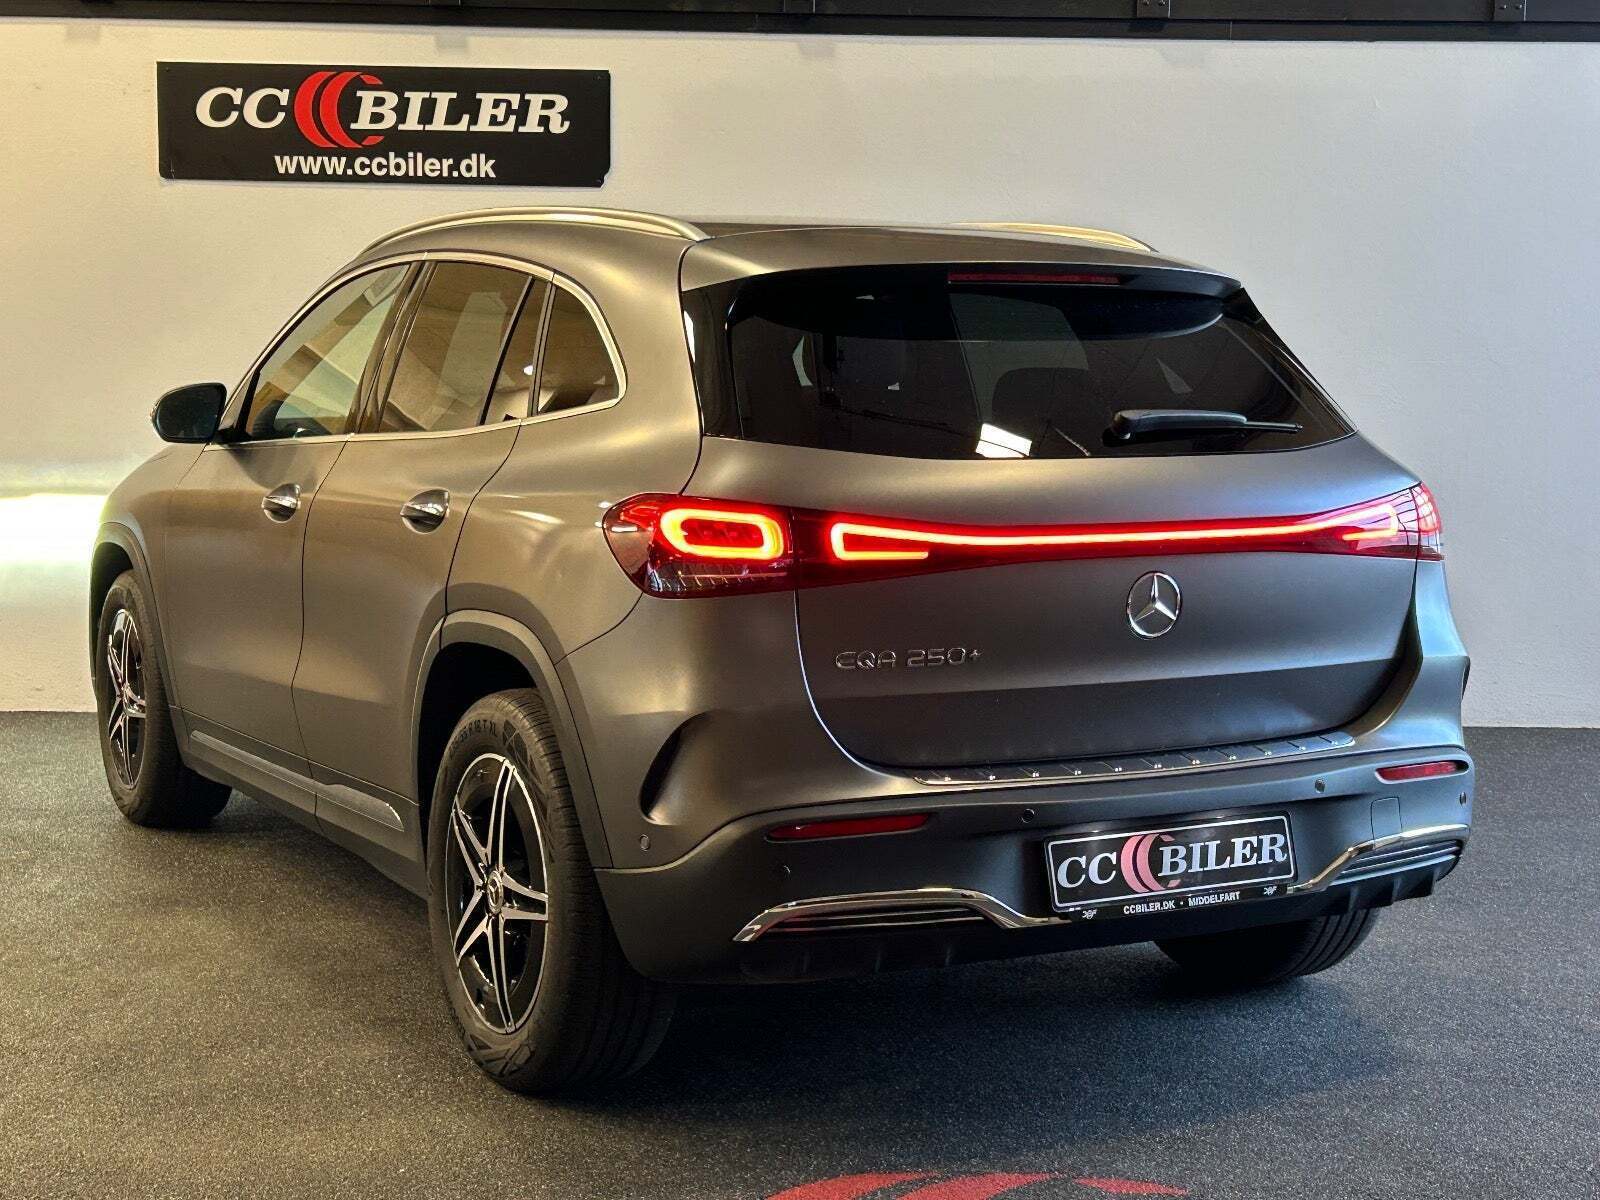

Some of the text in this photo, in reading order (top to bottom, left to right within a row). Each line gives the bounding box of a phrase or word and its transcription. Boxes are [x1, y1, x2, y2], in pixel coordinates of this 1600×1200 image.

[195, 86, 572, 135] CC BILER
[274, 152, 497, 180] www.ccbiler.dk
[905, 647, 983, 668] 250+
[1057, 833, 1288, 889] CC BILER
[1123, 891, 1241, 915] CCBILER.DK MIDDELFART
